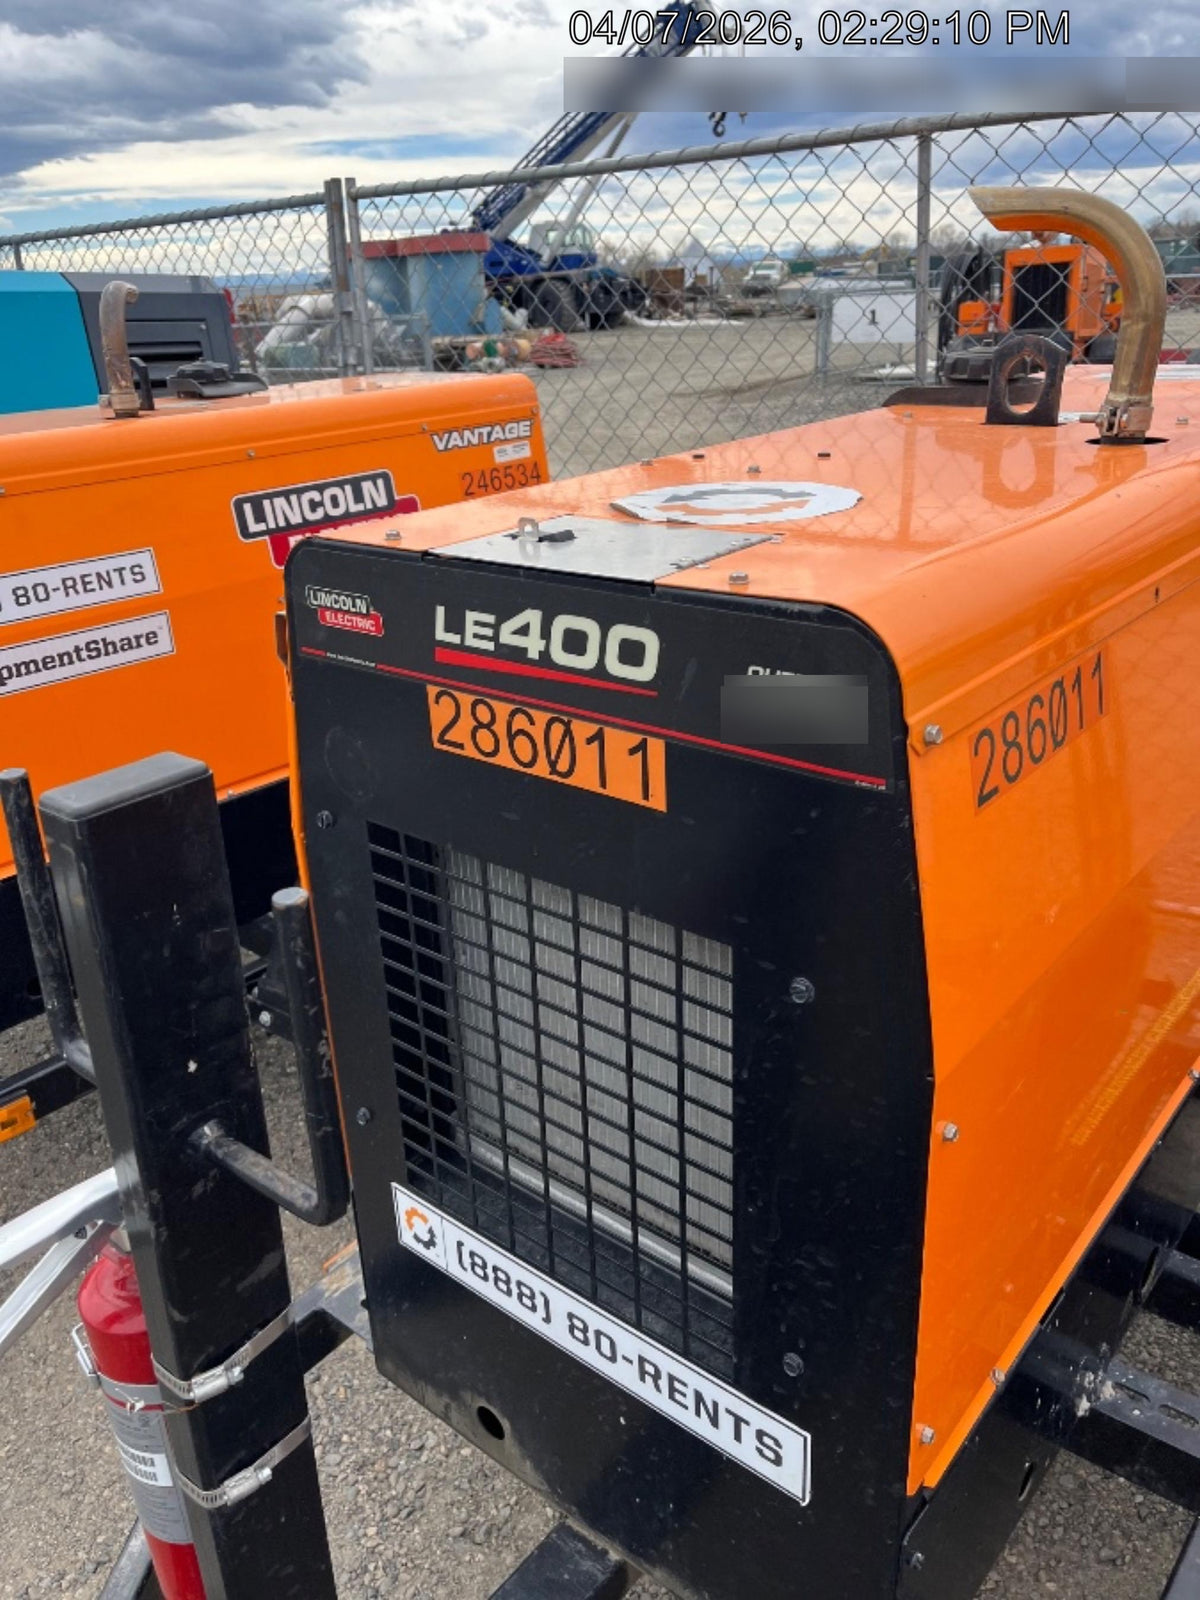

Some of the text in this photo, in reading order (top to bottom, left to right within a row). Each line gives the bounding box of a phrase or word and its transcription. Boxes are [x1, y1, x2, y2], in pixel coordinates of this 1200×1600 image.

[431, 419, 532, 452] VANTAGE
[462, 461, 541, 497] 246534
[243, 478, 389, 533] LINCOLN
[12, 564, 147, 607] 80-RENTS
[310, 589, 368, 614] LINCOLN
[325, 611, 376, 632] ELECTRIC
[434, 605, 660, 682] LE400
[434, 689, 650, 802] 286011
[973, 651, 1103, 808] 286011
[455, 1239, 784, 1468] (888) 80-RENTS
